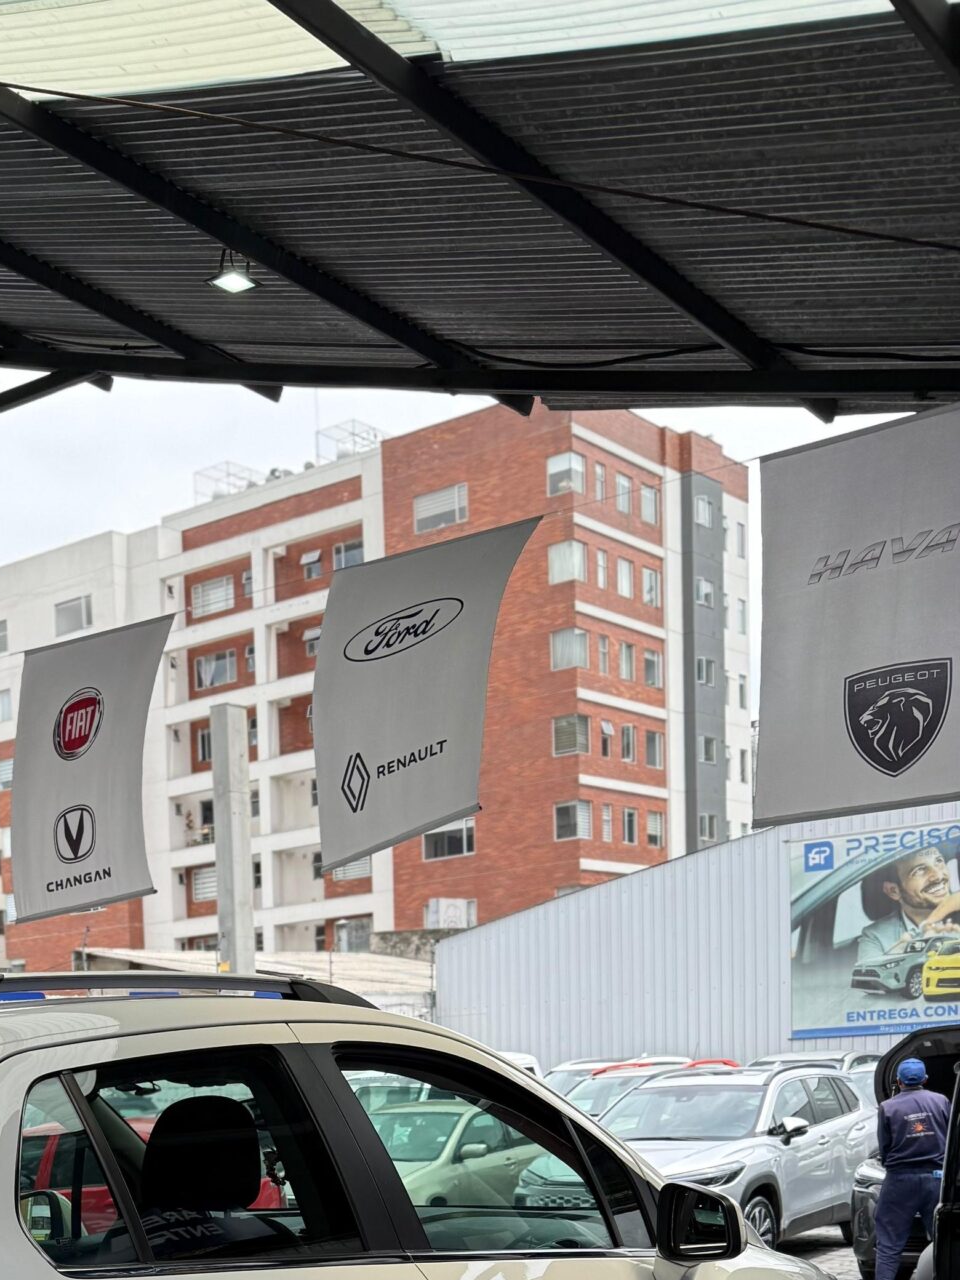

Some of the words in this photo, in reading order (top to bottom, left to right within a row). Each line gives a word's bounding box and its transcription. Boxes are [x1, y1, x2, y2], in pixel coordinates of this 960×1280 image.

[363, 608, 440, 655] Ford
[854, 669, 941, 692] PEUGEOT
[65, 705, 95, 742] FIAT
[376, 739, 448, 779] RENAULT
[46, 867, 112, 893] CHANGAN
[846, 1007, 920, 1022] ENTREGA
[923, 1005, 959, 1018] CON
